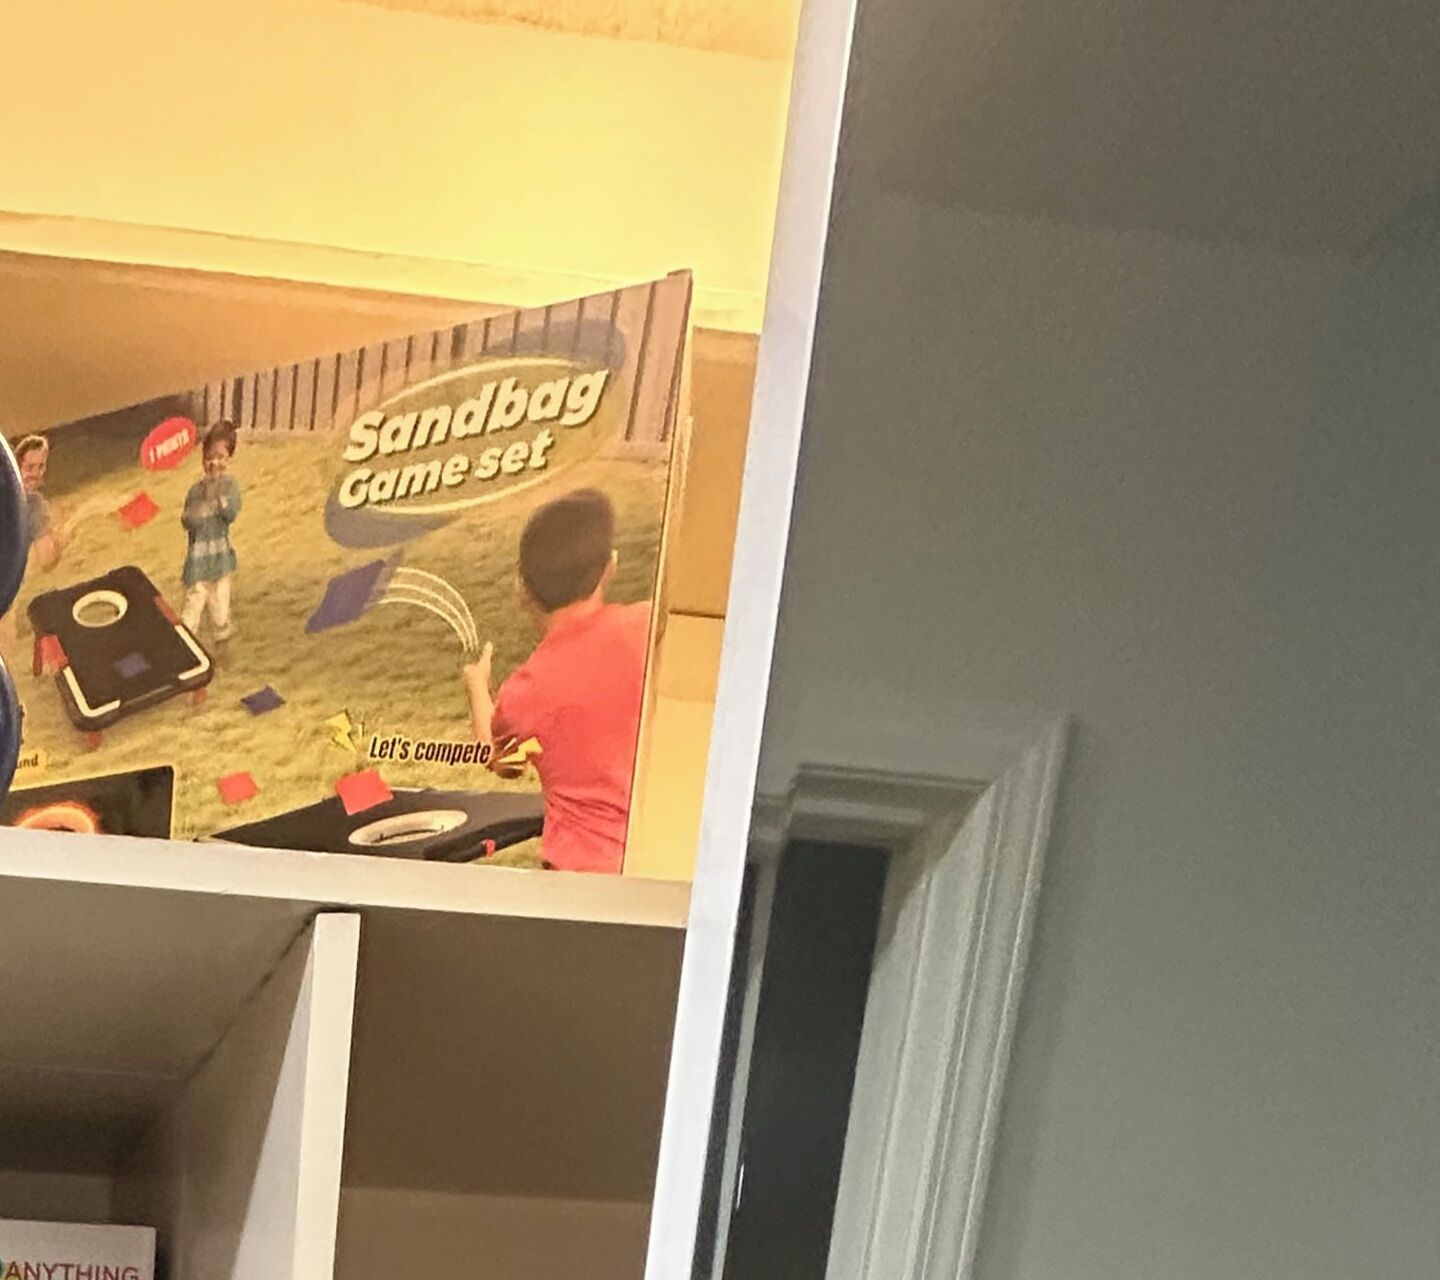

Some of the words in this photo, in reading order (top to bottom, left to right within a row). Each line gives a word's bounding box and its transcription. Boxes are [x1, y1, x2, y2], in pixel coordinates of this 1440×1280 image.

[343, 369, 609, 463] Sandbag
[339, 455, 469, 508] Game
[474, 427, 555, 480] set
[369, 736, 411, 760] Let's
[413, 740, 492, 766] compete
